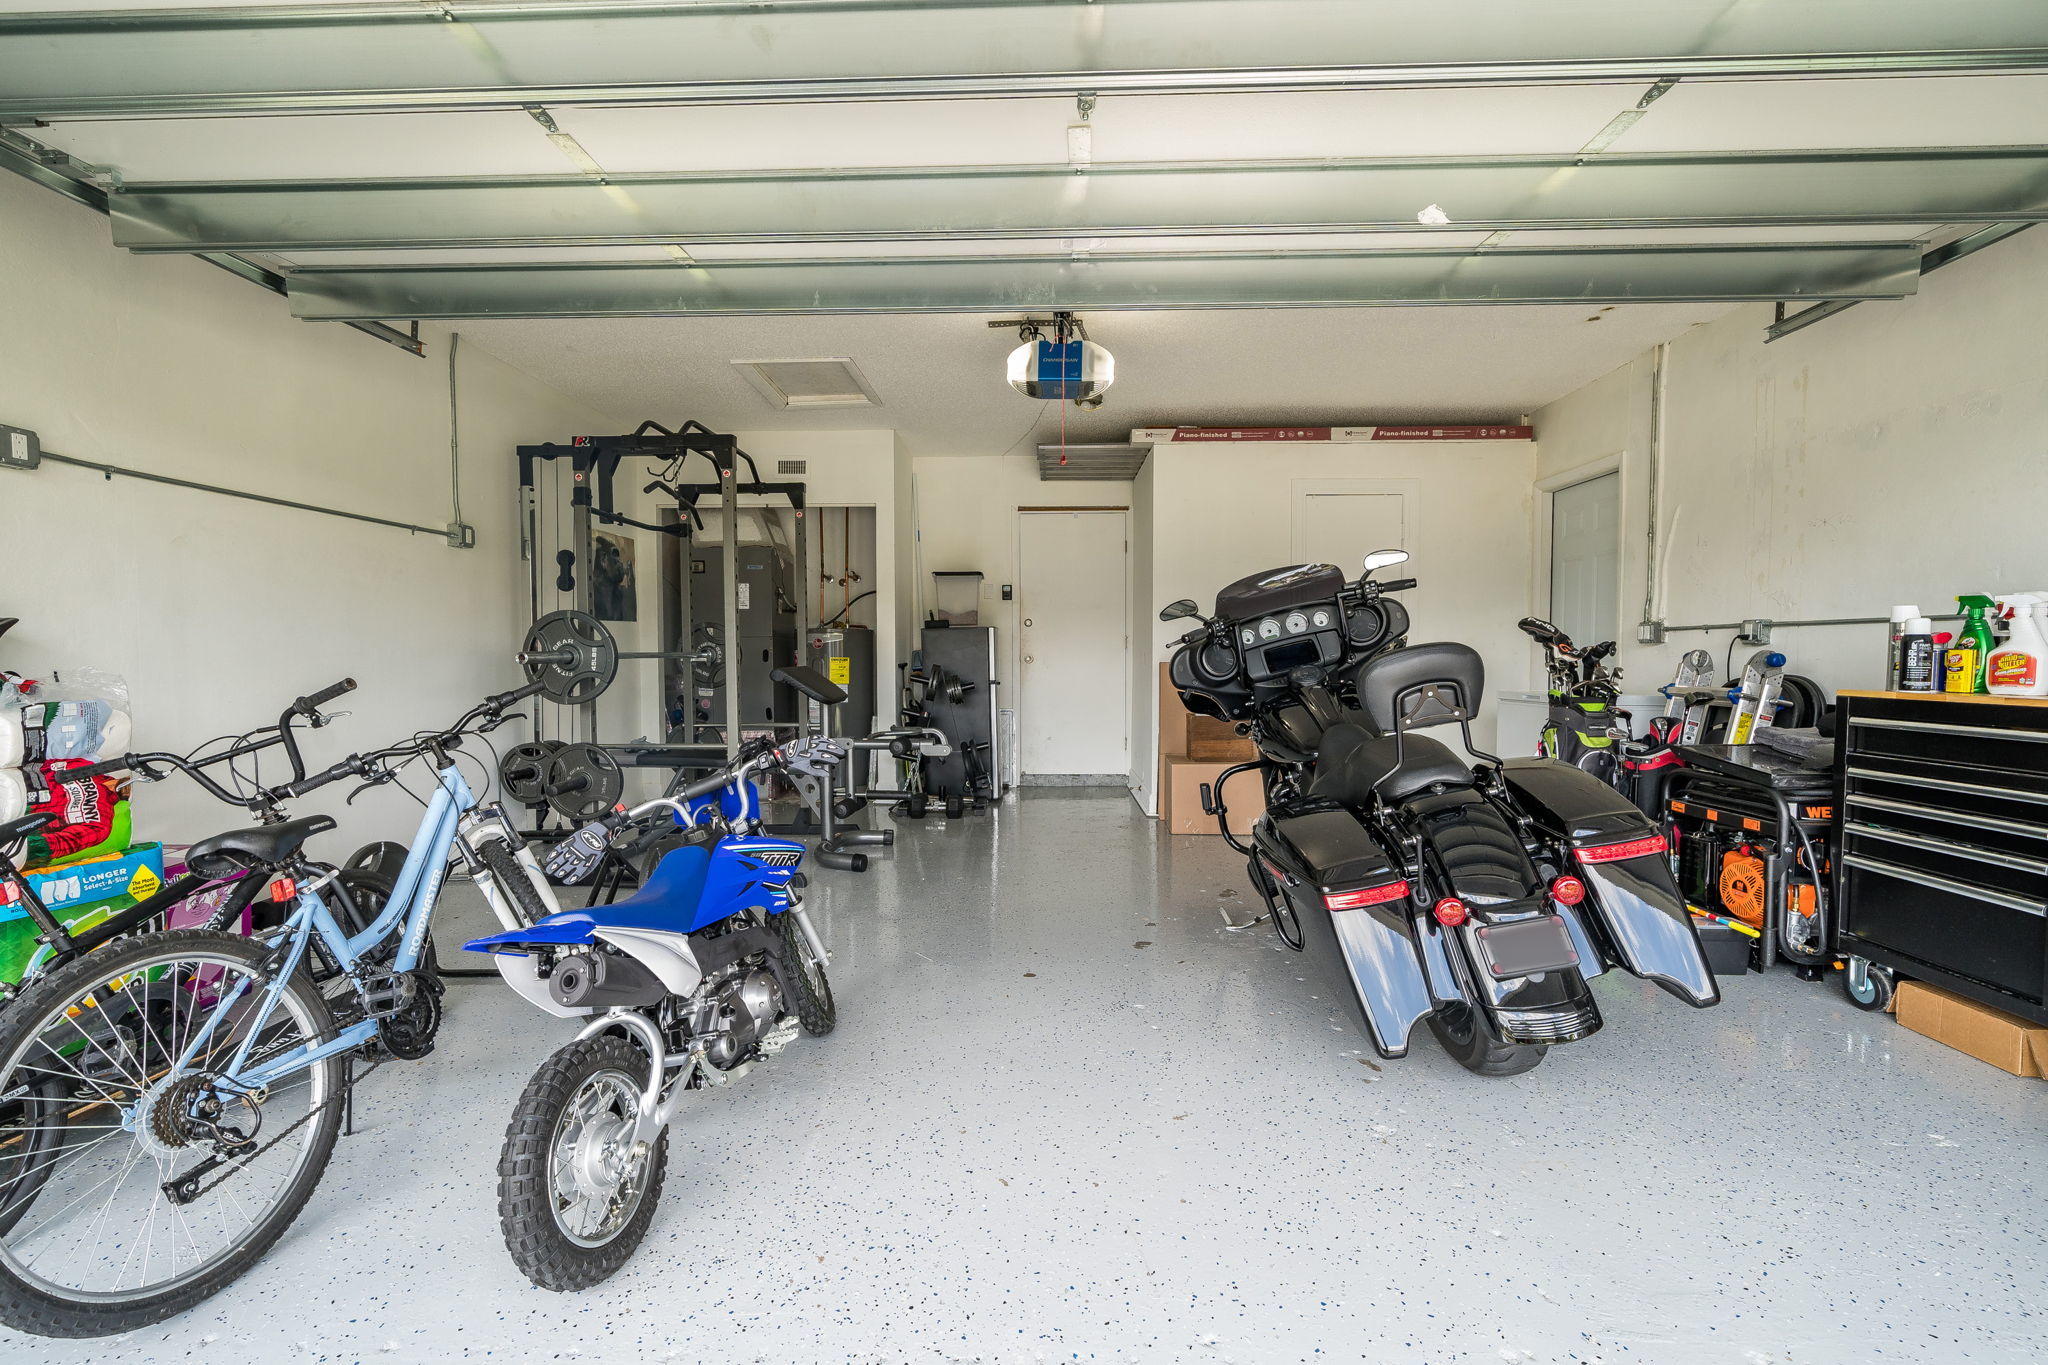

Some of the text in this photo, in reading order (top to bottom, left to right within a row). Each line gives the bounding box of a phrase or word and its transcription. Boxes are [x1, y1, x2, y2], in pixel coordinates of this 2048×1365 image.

[1528, 616, 1556, 633] PING
[552, 638, 574, 651] GEAR
[1907, 649, 1918, 667] BEHR
[552, 663, 573, 677] FITNE
[79, 775, 100, 823] BRAWNY
[1805, 806, 1833, 819] WE
[82, 868, 127, 884] LONGER
